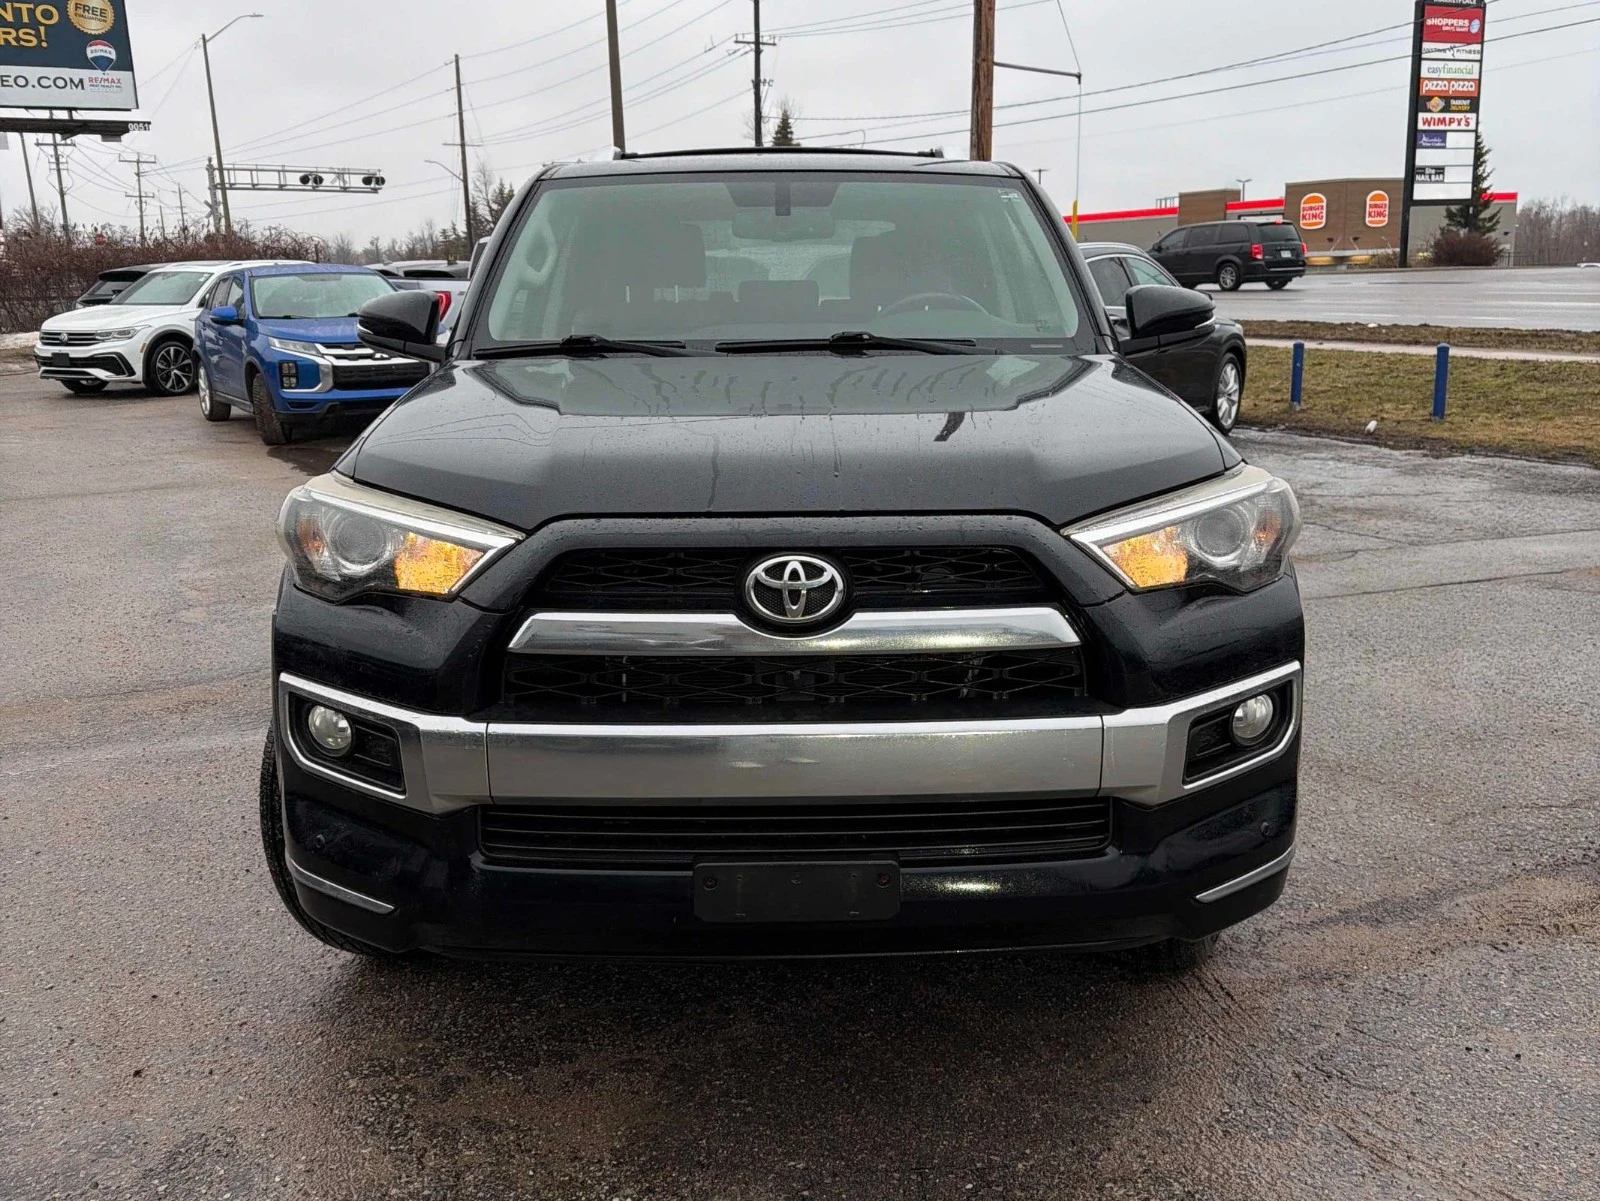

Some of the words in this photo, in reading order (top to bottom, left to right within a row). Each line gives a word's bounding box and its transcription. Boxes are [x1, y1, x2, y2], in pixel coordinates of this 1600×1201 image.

[0, 2, 59, 25] NTO
[74, 2, 107, 19] FREE
[74, 12, 107, 23] EVALUATION
[1426, 17, 1470, 27] SHOPPERS
[0, 26, 48, 48] RS!
[90, 48, 112, 56] RE/MAX
[1427, 63, 1474, 77] easyfinancial
[0, 74, 85, 90] EO.COM
[88, 76, 122, 85] RE/MAX
[1422, 80, 1449, 94] pizza
[1449, 80, 1475, 95] pizza
[1422, 115, 1470, 127] WIMPY'S
[1415, 174, 1430, 182] NAIL
[1431, 174, 1444, 182] BAR
[1302, 204, 1324, 212] BURGER
[1301, 212, 1324, 221] KING
[1368, 210, 1387, 218] KING
